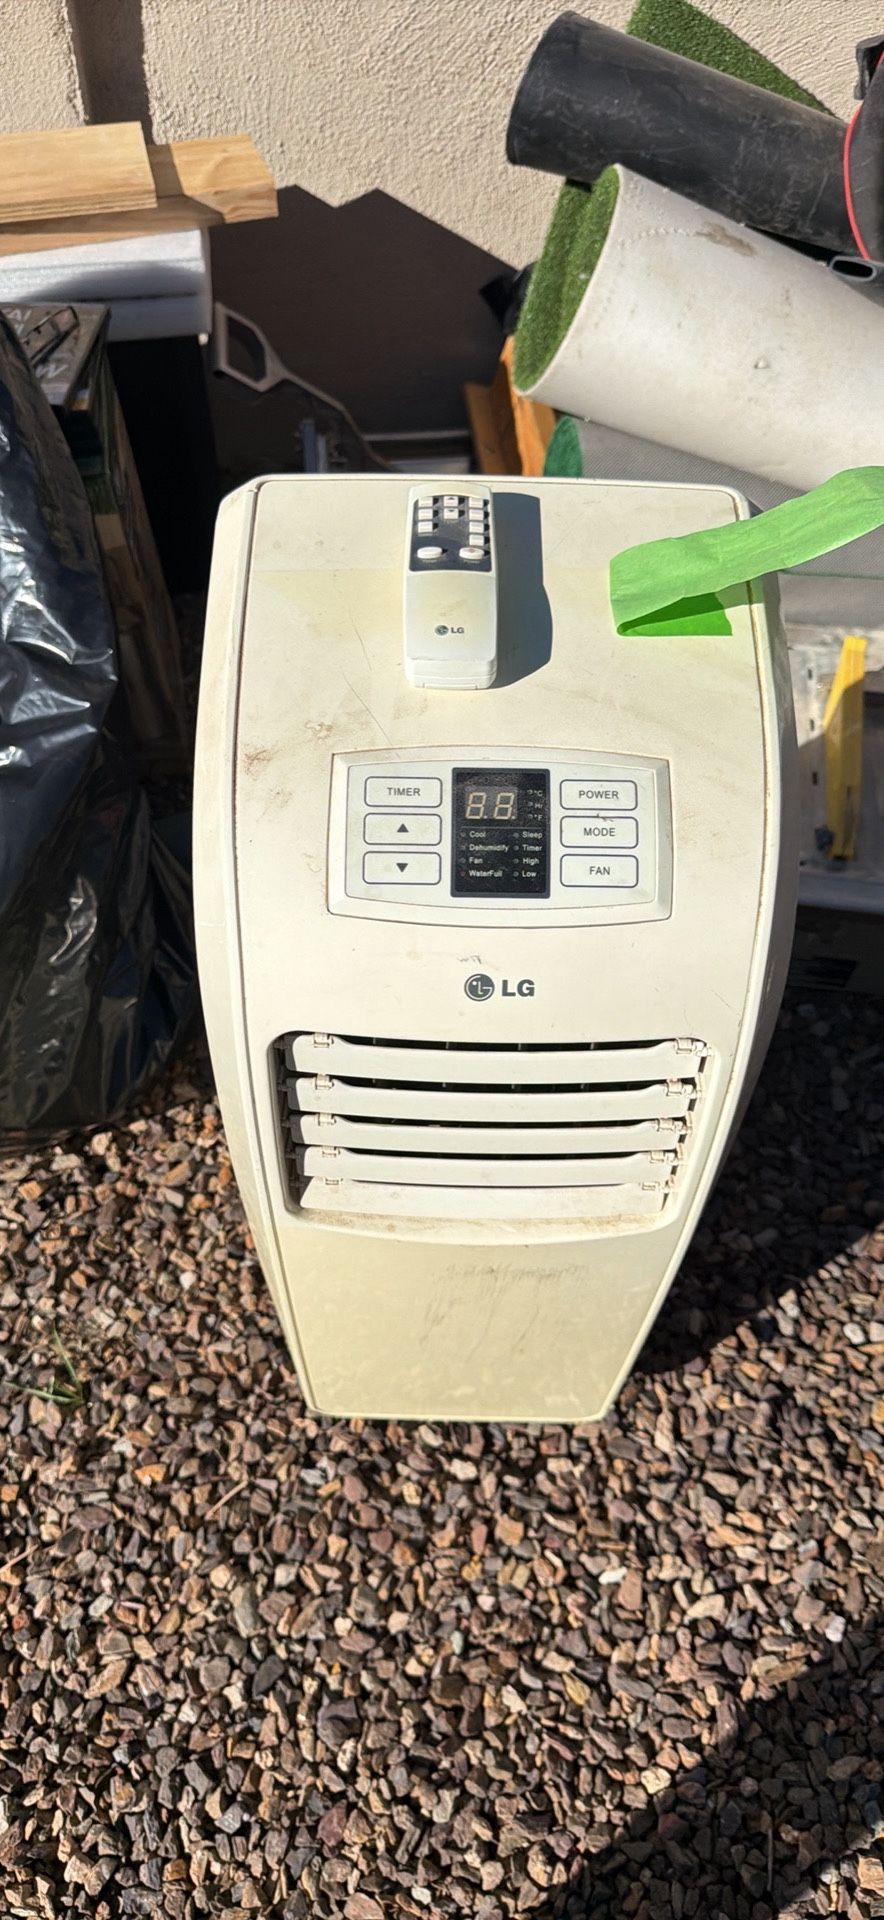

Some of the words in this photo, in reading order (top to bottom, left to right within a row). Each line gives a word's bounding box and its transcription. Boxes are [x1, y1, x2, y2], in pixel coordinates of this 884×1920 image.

[386, 787, 421, 797] TIMER
[578, 790, 619, 799] POWER
[522, 831, 543, 840] Sleep
[583, 827, 616, 837] MODE
[469, 844, 509, 853] Dehumidify
[523, 857, 540, 866] High
[589, 866, 610, 875] FAN
[501, 979, 535, 997] LG
